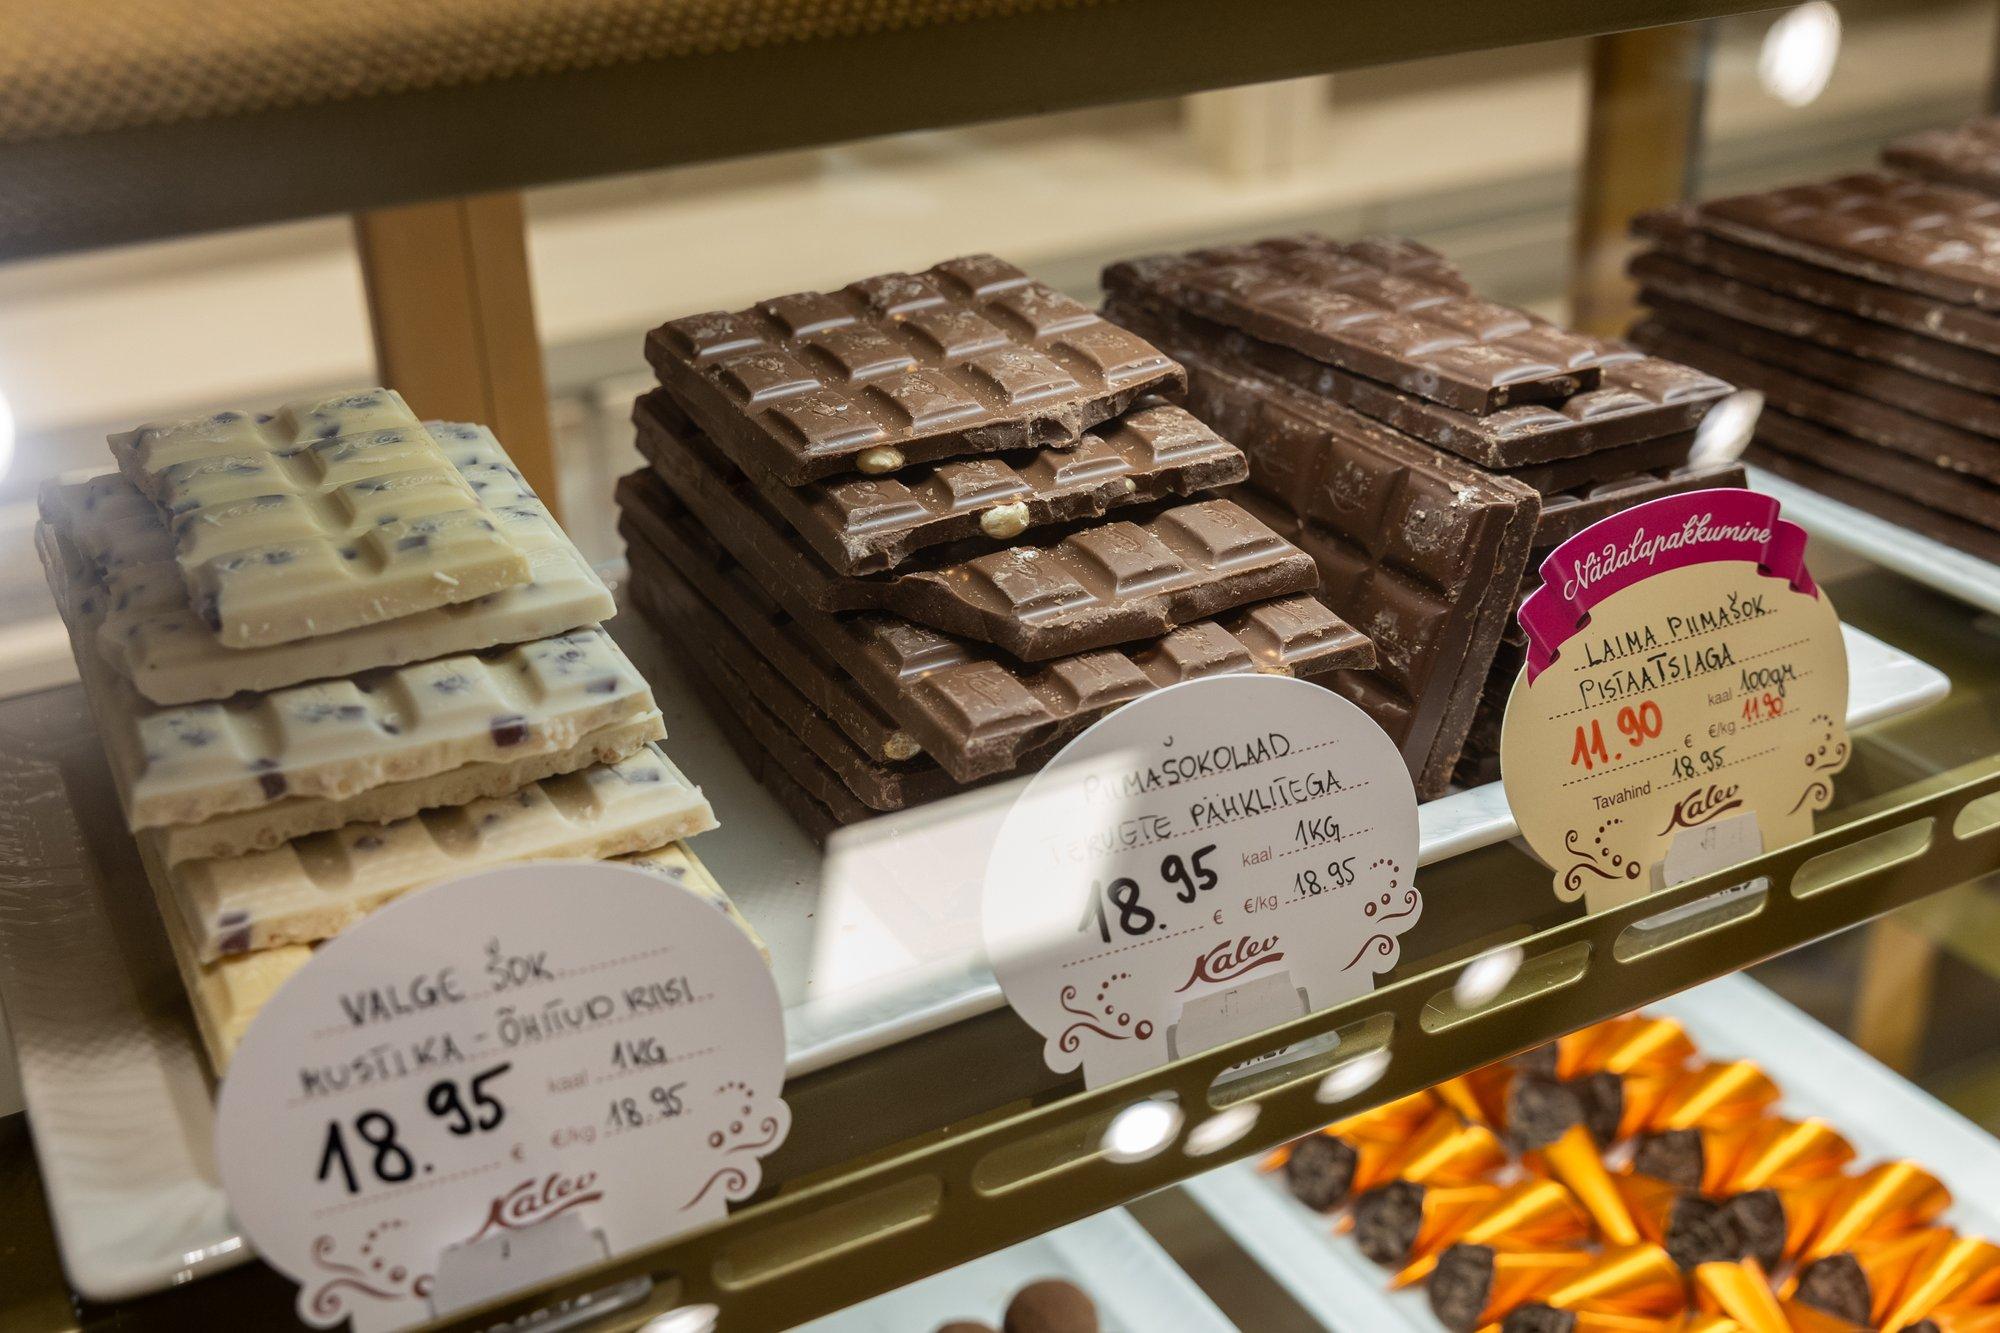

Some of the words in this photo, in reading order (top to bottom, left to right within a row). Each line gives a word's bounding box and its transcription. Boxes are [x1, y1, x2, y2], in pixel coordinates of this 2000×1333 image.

[1564, 512, 1773, 601] Nädalapakkumine
[1585, 625, 1657, 667] LAIMA
[1666, 591, 1767, 638] PIIMAŠOK
[1579, 643, 1736, 709] PISTAATSIAGA
[1708, 688, 1733, 706] kaal
[1571, 699, 1663, 770] 11.90
[1684, 734, 1693, 748] €
[1708, 720, 1736, 738] €/kg
[1190, 769, 1342, 827] PÄHKLITEGA
[1593, 781, 1651, 810] Tavahind
[1672, 745, 1726, 779] 18.95
[1242, 846, 1272, 867] kaal
[1295, 815, 1341, 847] 1KG
[1657, 784, 1744, 837] Kalev
[1077, 843, 1218, 943] 18.95
[1213, 908, 1224, 925] €
[1243, 895, 1278, 913] €/kg
[1293, 857, 1356, 896] 18.95
[339, 966, 466, 1027] VALGE
[483, 935, 555, 992] ŠOK
[1174, 935, 1285, 993] Kalev
[611, 1036, 668, 1071] 1KG
[317, 1060, 512, 1194] 18.95
[606, 1080, 688, 1129] 18.95
[466, 1170, 605, 1246] Kalev
